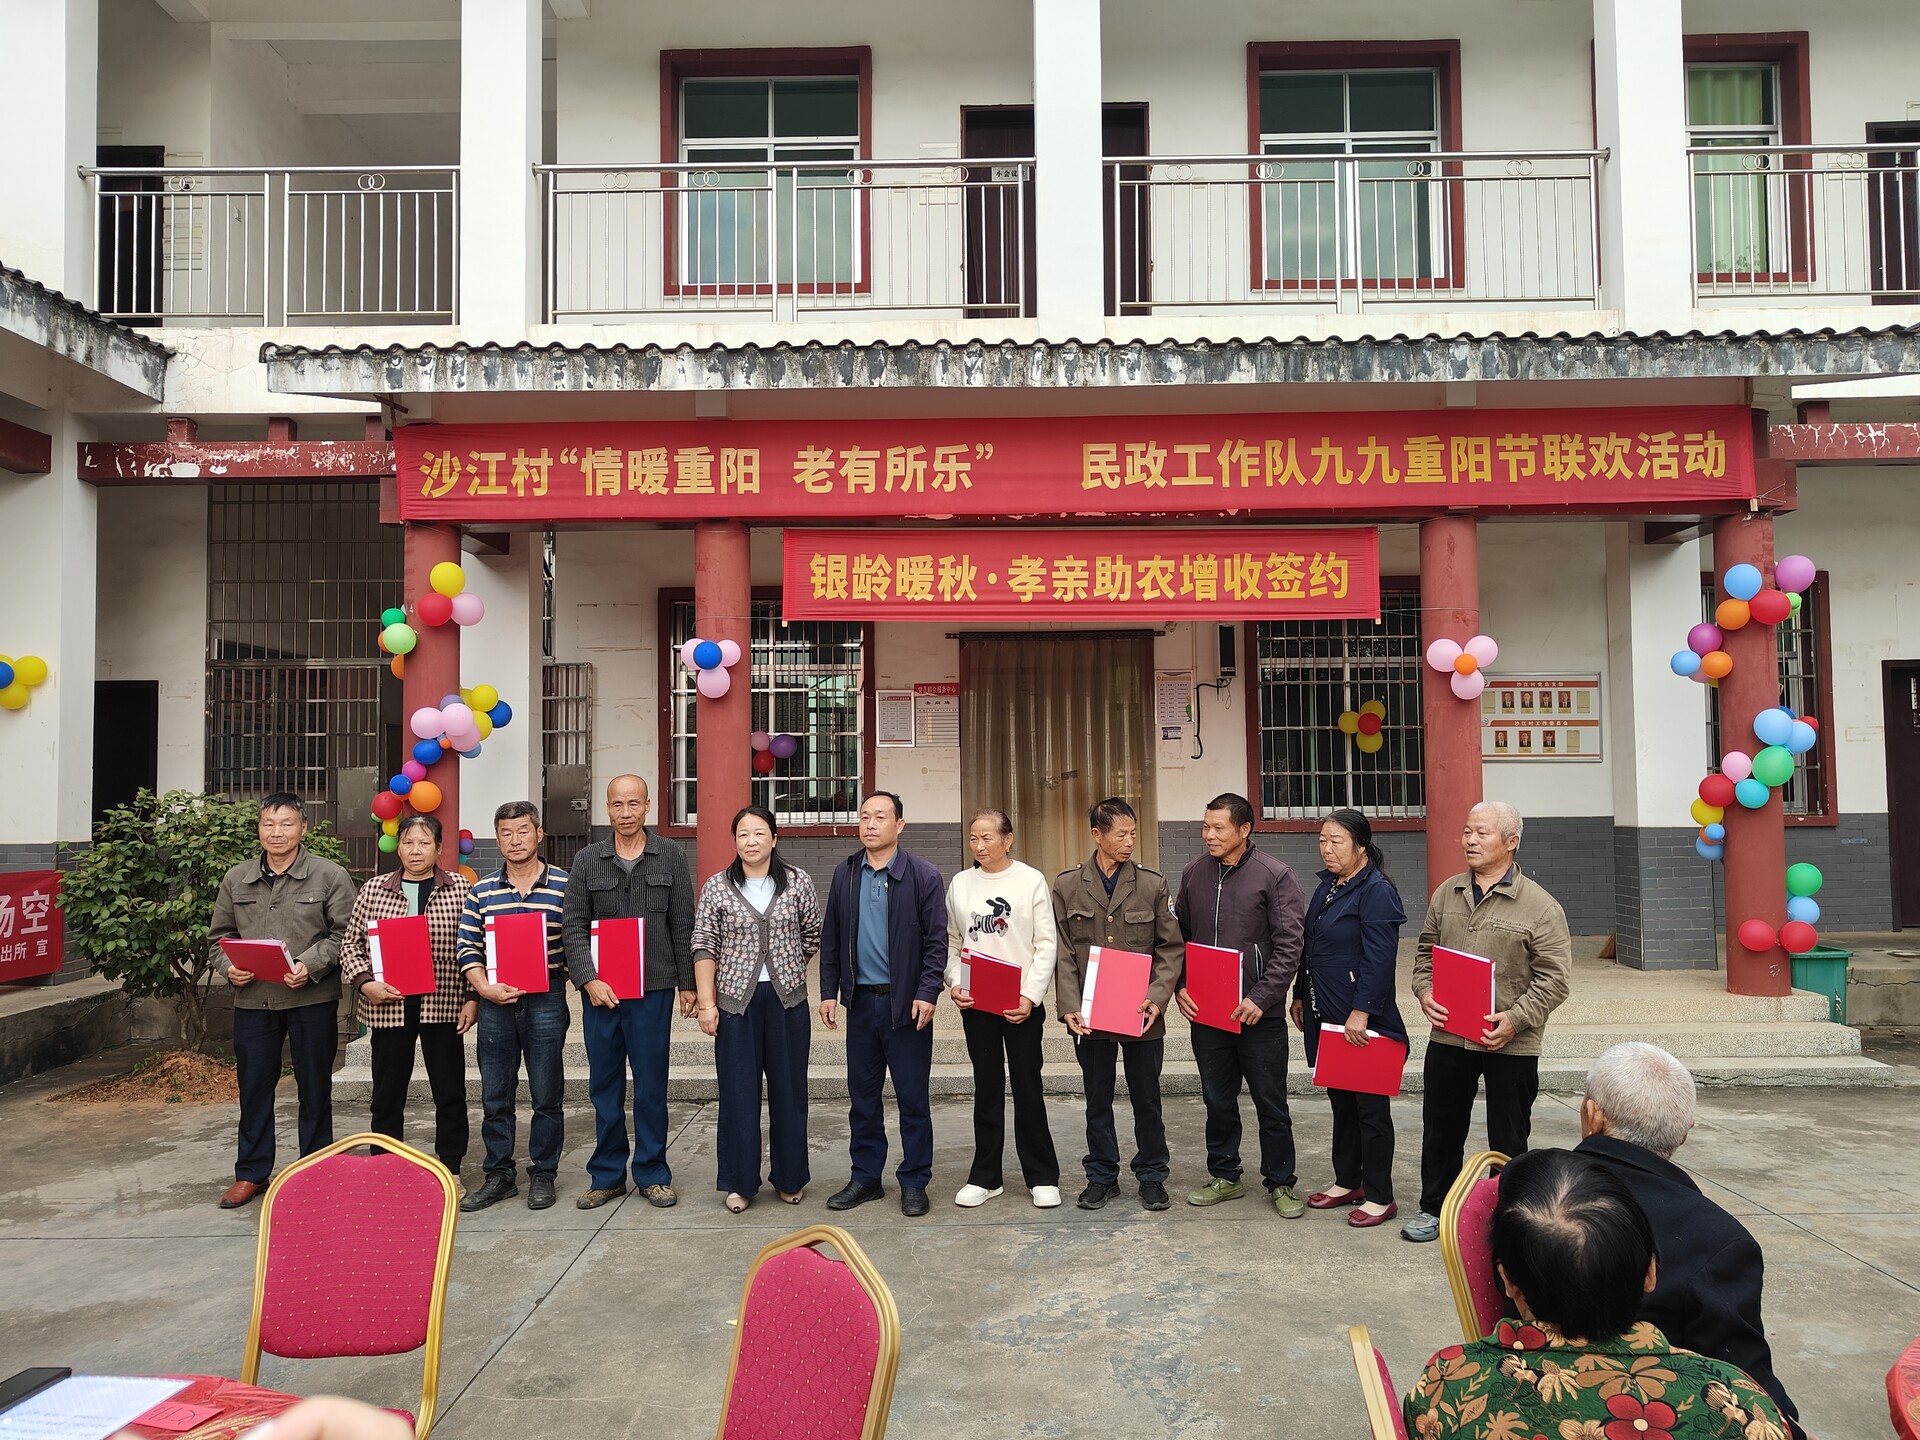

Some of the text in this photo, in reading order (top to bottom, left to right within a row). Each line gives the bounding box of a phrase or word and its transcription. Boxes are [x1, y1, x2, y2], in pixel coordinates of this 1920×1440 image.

[420, 430, 1727, 498] 沙江村“情暖重阳 老有所乐” 民政工作队九九重阳节联欢活动
[809, 552, 1350, 604] 银龄暖秋·孝亲助农增收签约
